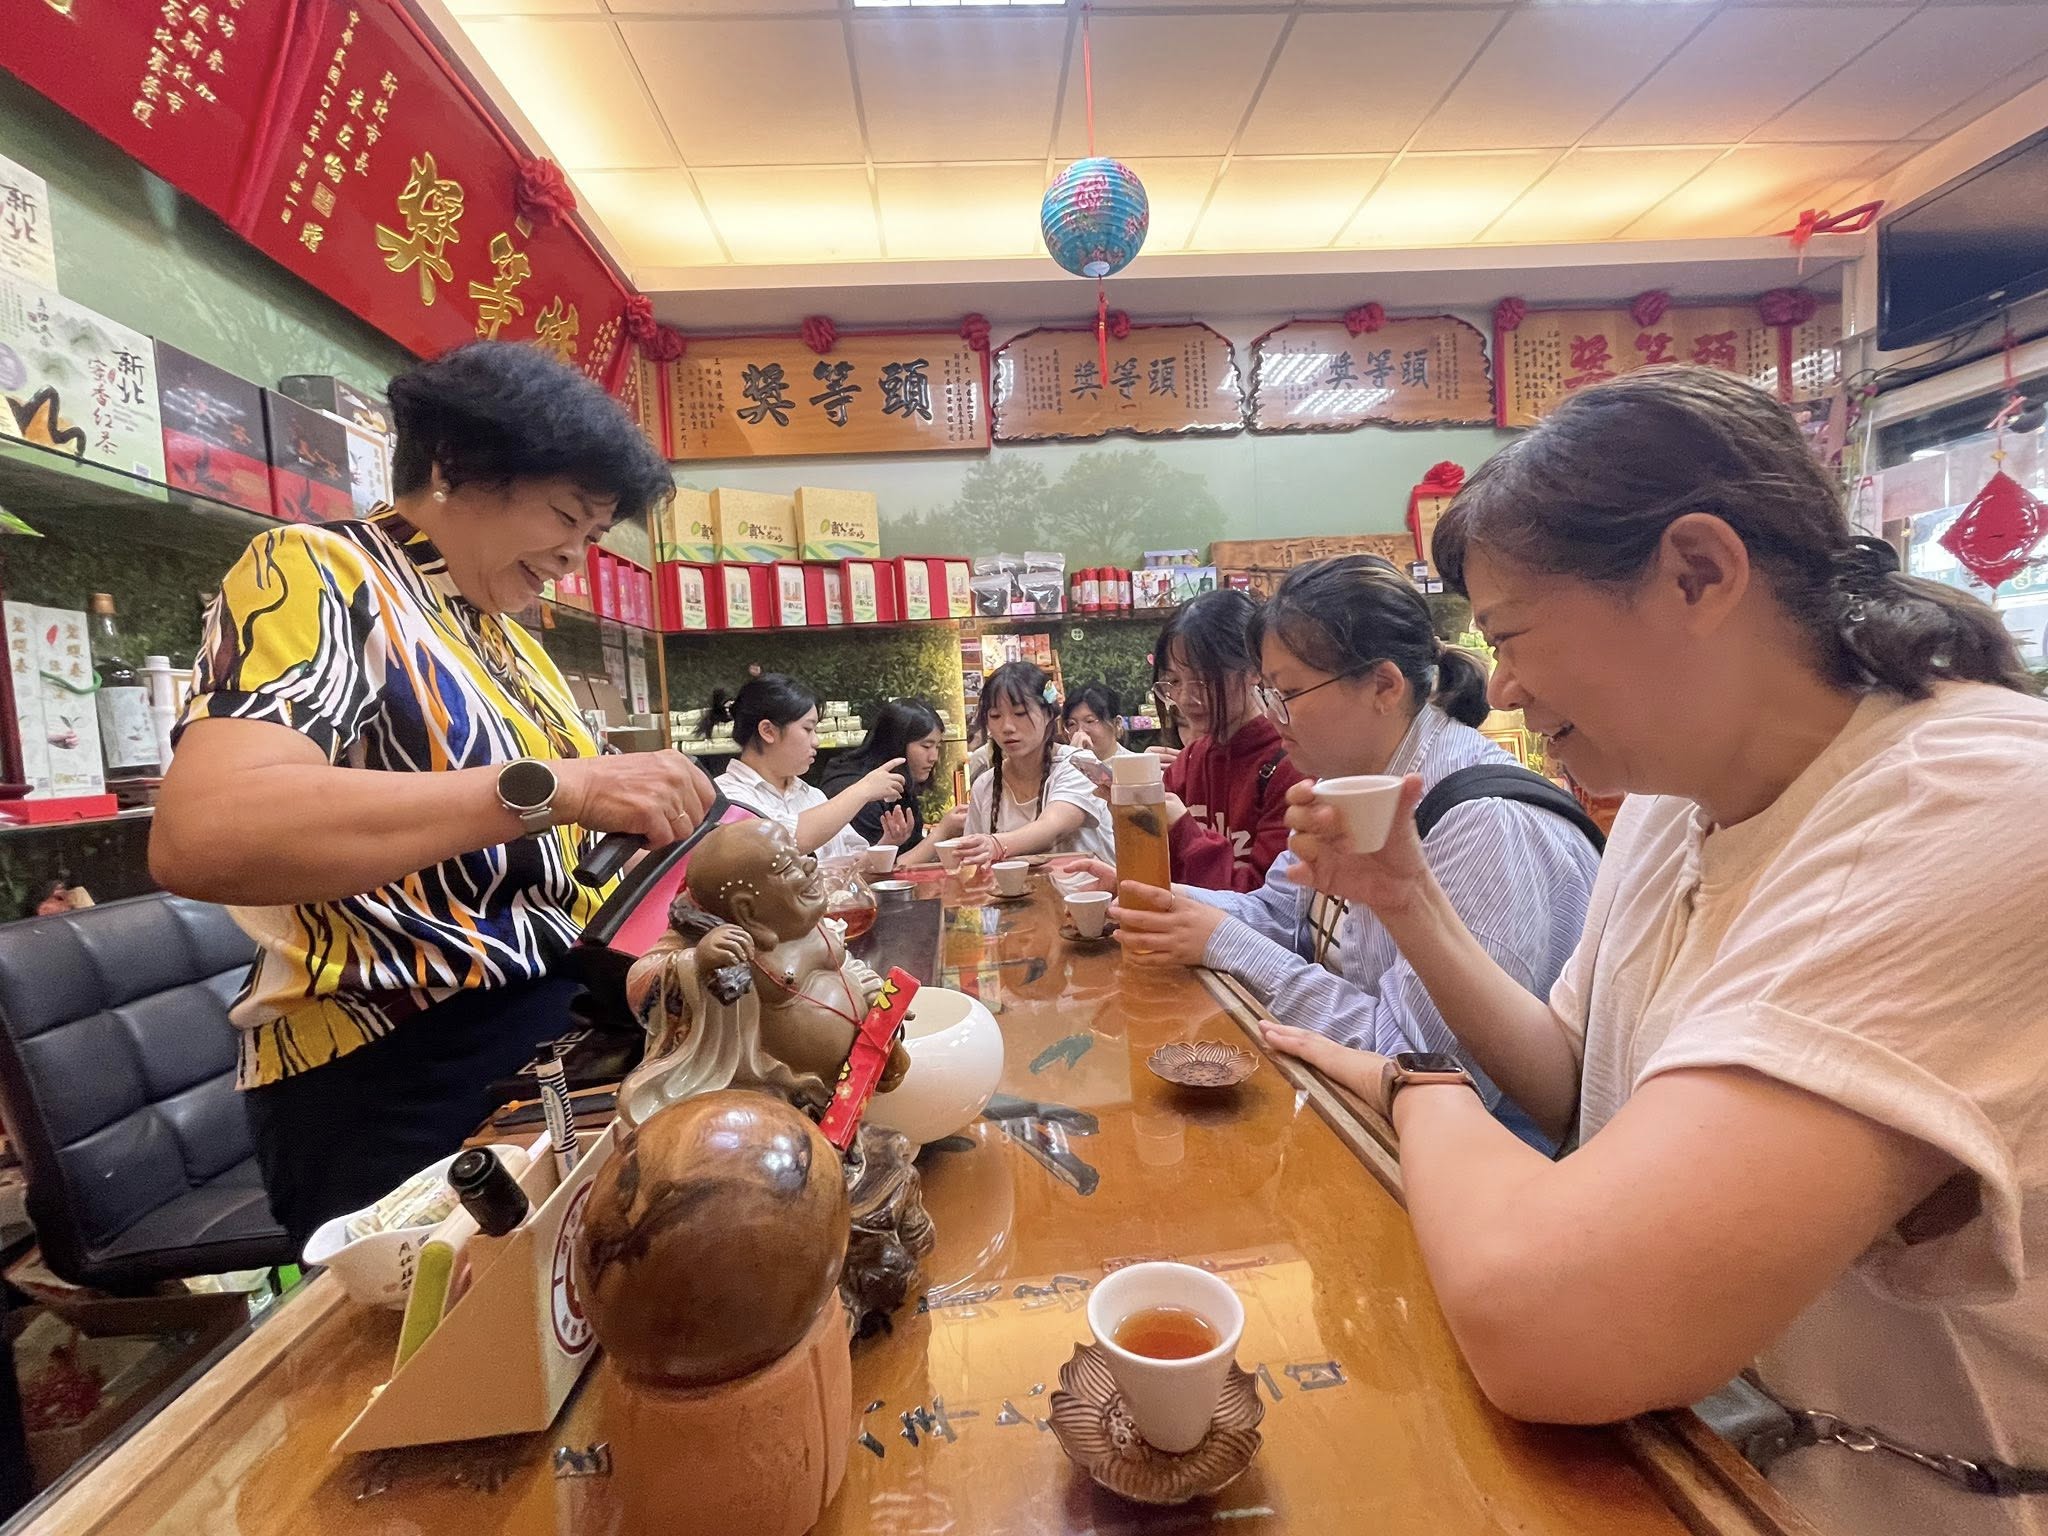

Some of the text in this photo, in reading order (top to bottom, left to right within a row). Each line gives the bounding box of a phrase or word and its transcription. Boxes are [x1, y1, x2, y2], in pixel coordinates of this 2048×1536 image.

[324, 88, 365, 184] 朱立倫
[355, 71, 398, 177] 新北市長
[1, 183, 37, 244] 新北
[112, 346, 145, 405] 新北
[736, 356, 935, 428] 頭等獎
[1070, 356, 1179, 401] 頭等獎
[1325, 348, 1430, 391] 頭等獎
